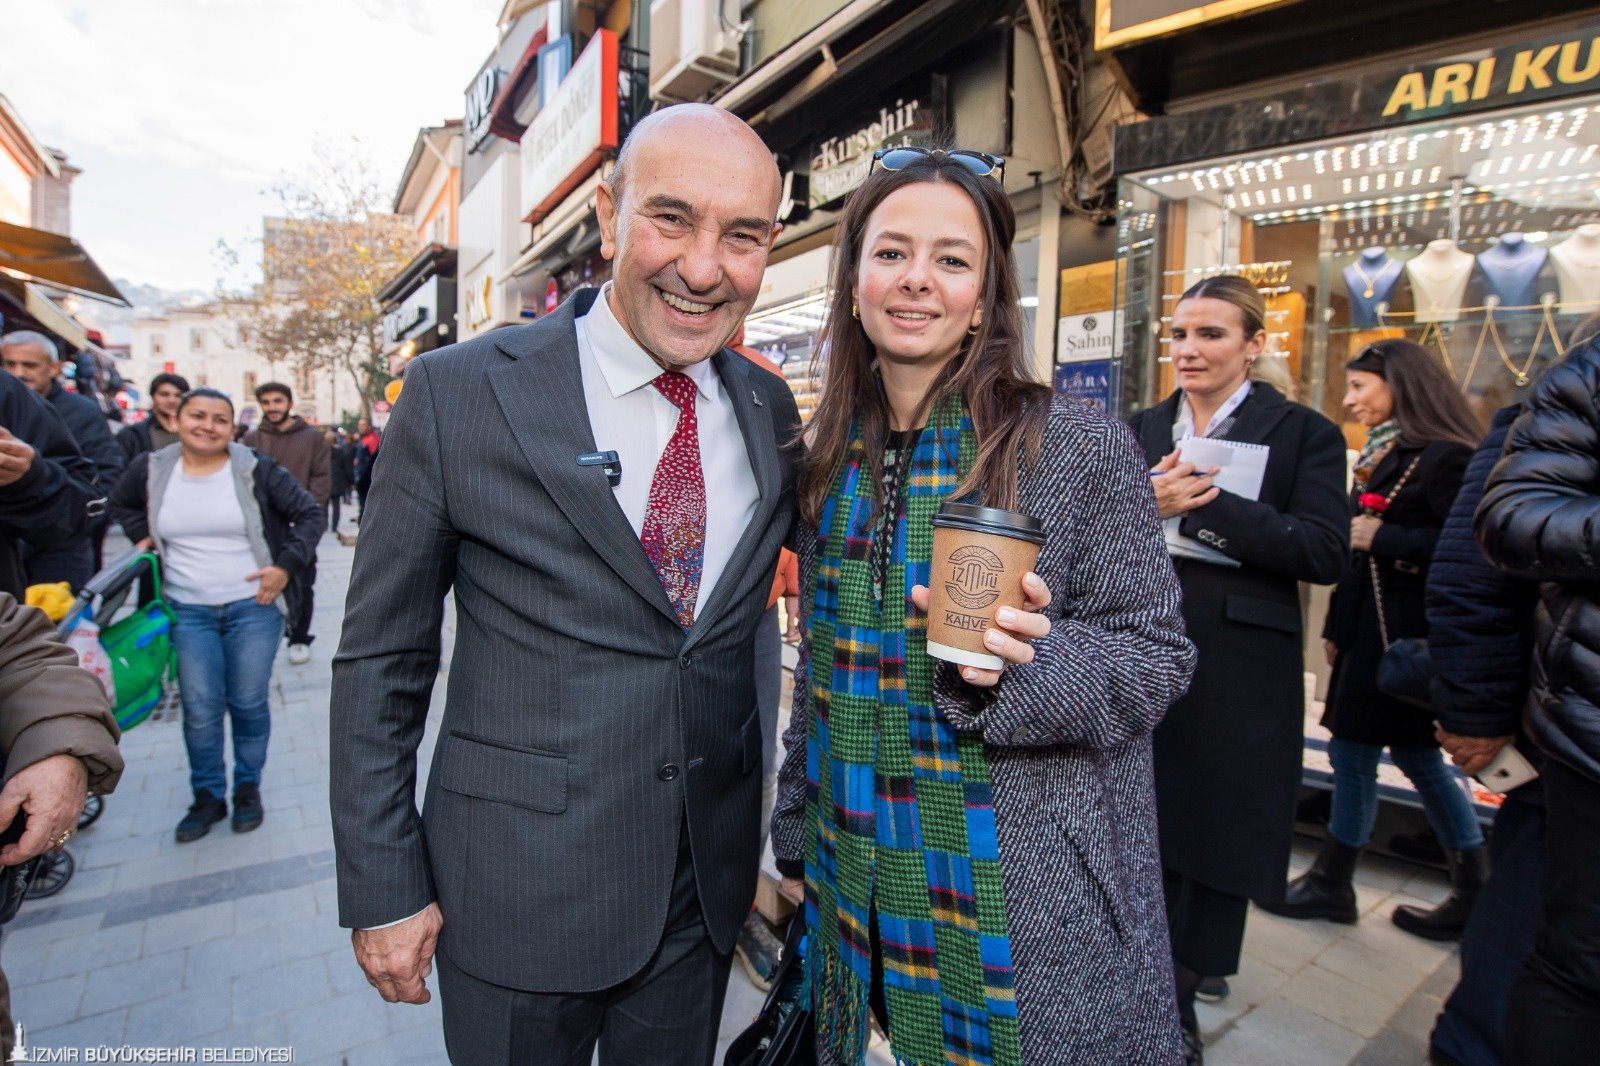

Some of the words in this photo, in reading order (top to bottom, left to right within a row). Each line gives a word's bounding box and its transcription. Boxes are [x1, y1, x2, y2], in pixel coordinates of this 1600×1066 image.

[1382, 57, 1496, 116] ARI
[1507, 36, 1600, 94] KU
[1067, 332, 1112, 352] Şahin
[945, 613, 988, 630] KAHVE
